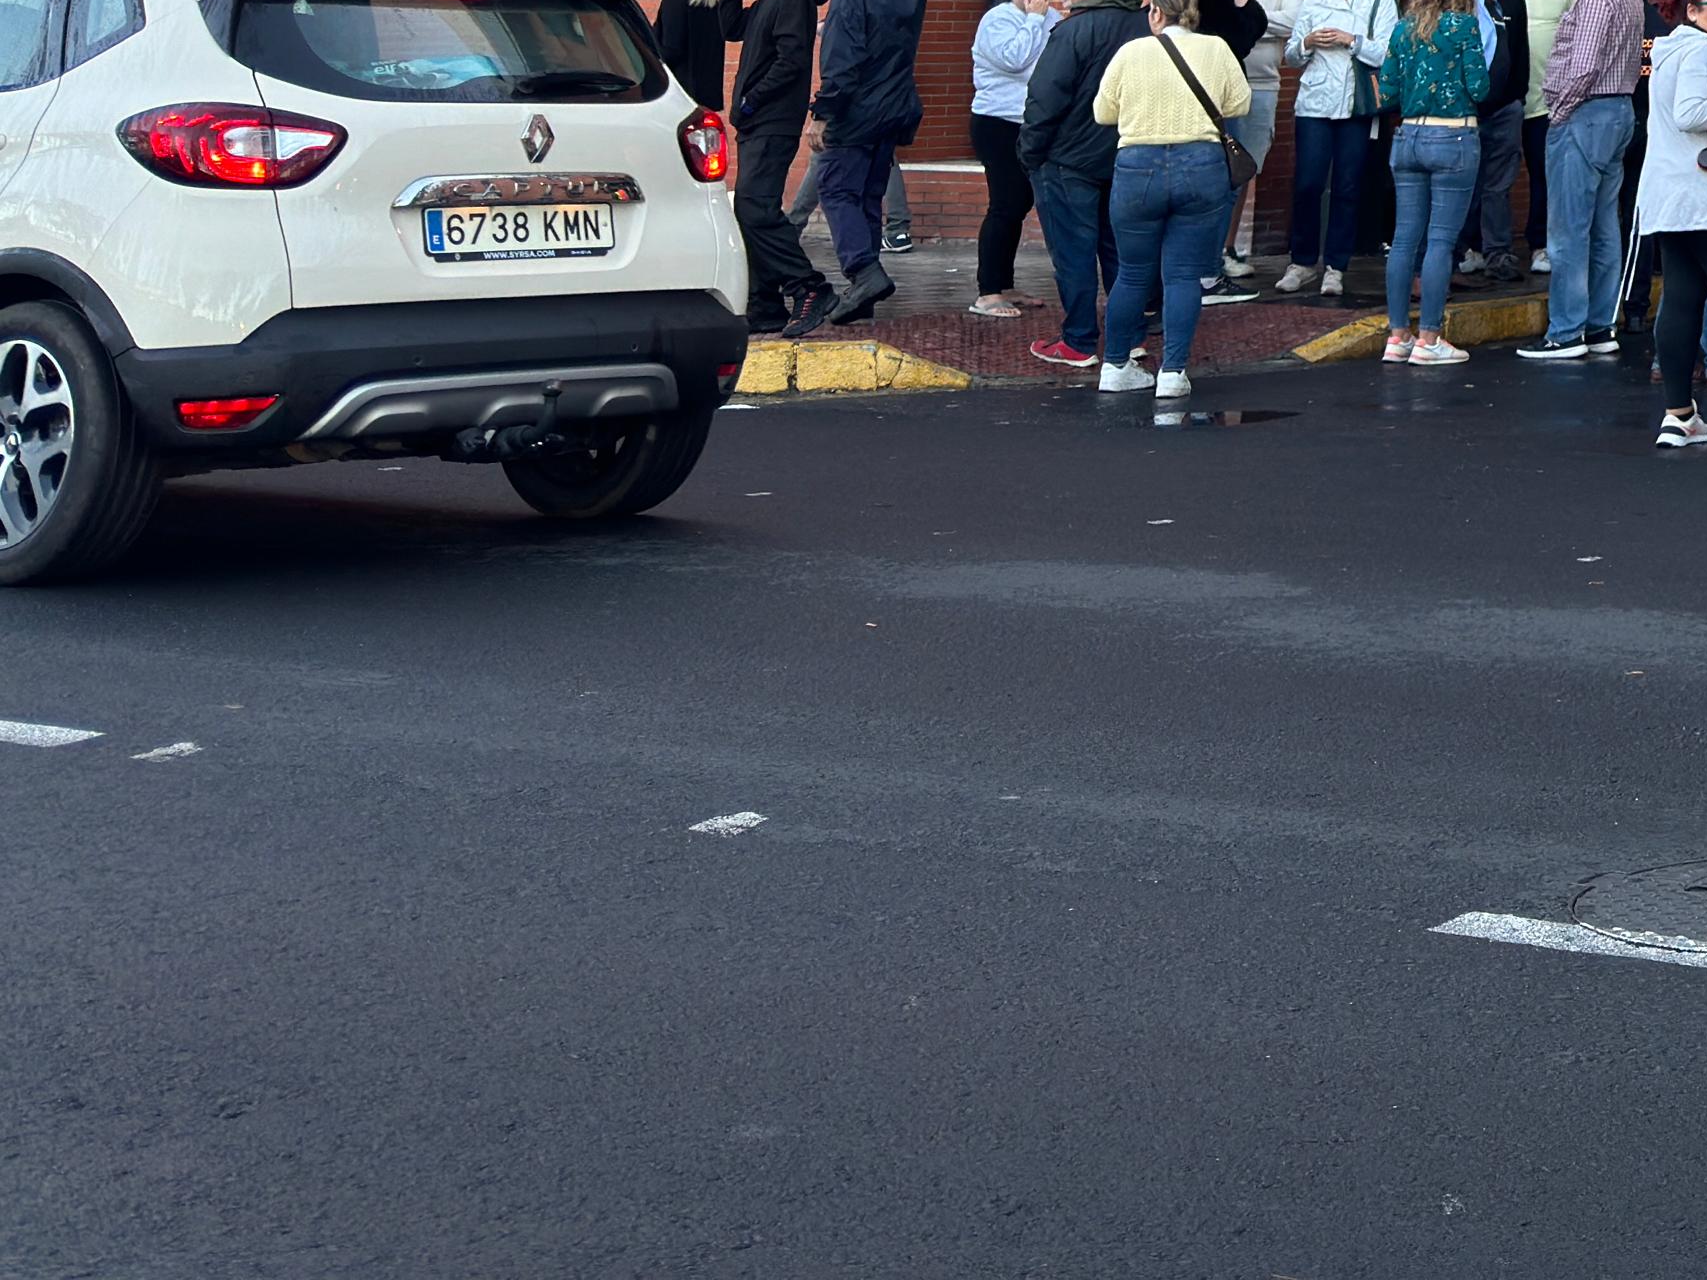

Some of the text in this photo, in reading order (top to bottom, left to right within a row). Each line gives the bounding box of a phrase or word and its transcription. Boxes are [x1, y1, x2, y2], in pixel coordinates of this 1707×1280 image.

[453, 179, 611, 197] CAPTUR
[446, 209, 601, 246] 6738 KMN
[433, 234, 440, 244] E
[484, 249, 556, 260] WWW.SYRSA.COM
